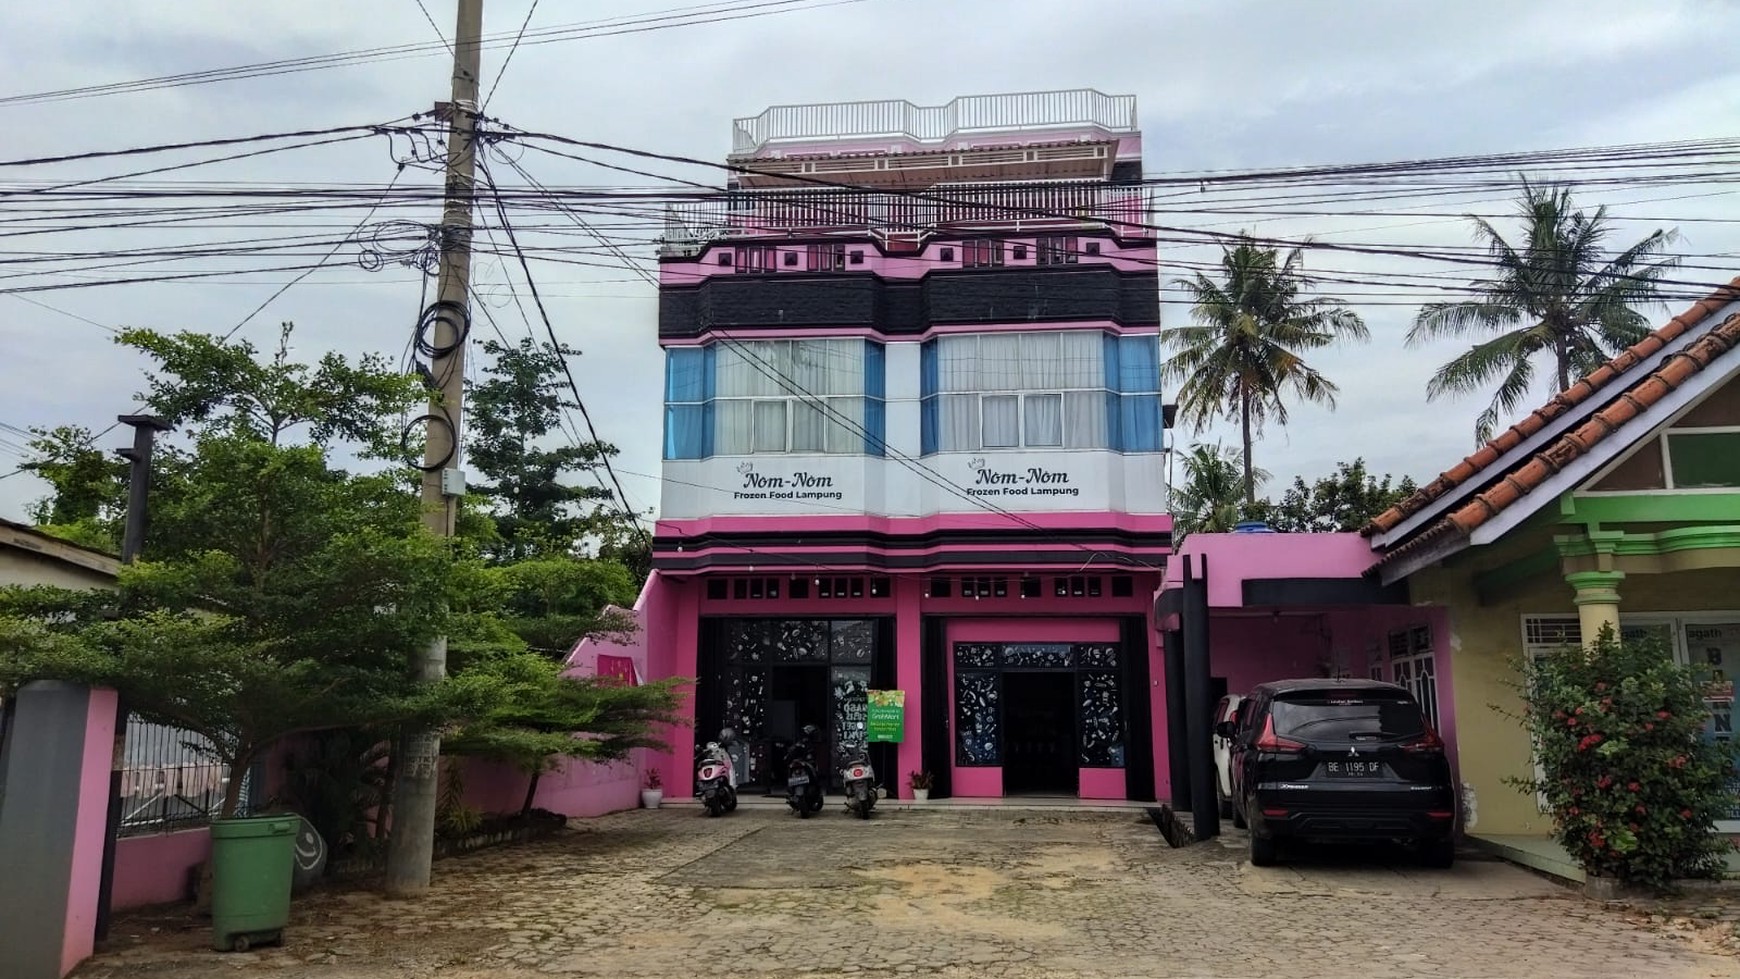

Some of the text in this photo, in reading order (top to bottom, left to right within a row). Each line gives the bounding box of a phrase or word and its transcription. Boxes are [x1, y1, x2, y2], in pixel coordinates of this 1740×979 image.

[743, 472, 833, 488] Nom-Nom
[975, 467, 1069, 485] Nom-Nom
[734, 491, 842, 500] Frozen Food Lampung
[966, 487, 1079, 496] Frozen Food Lampung
[1328, 762, 1379, 772] BE 1195 DF
